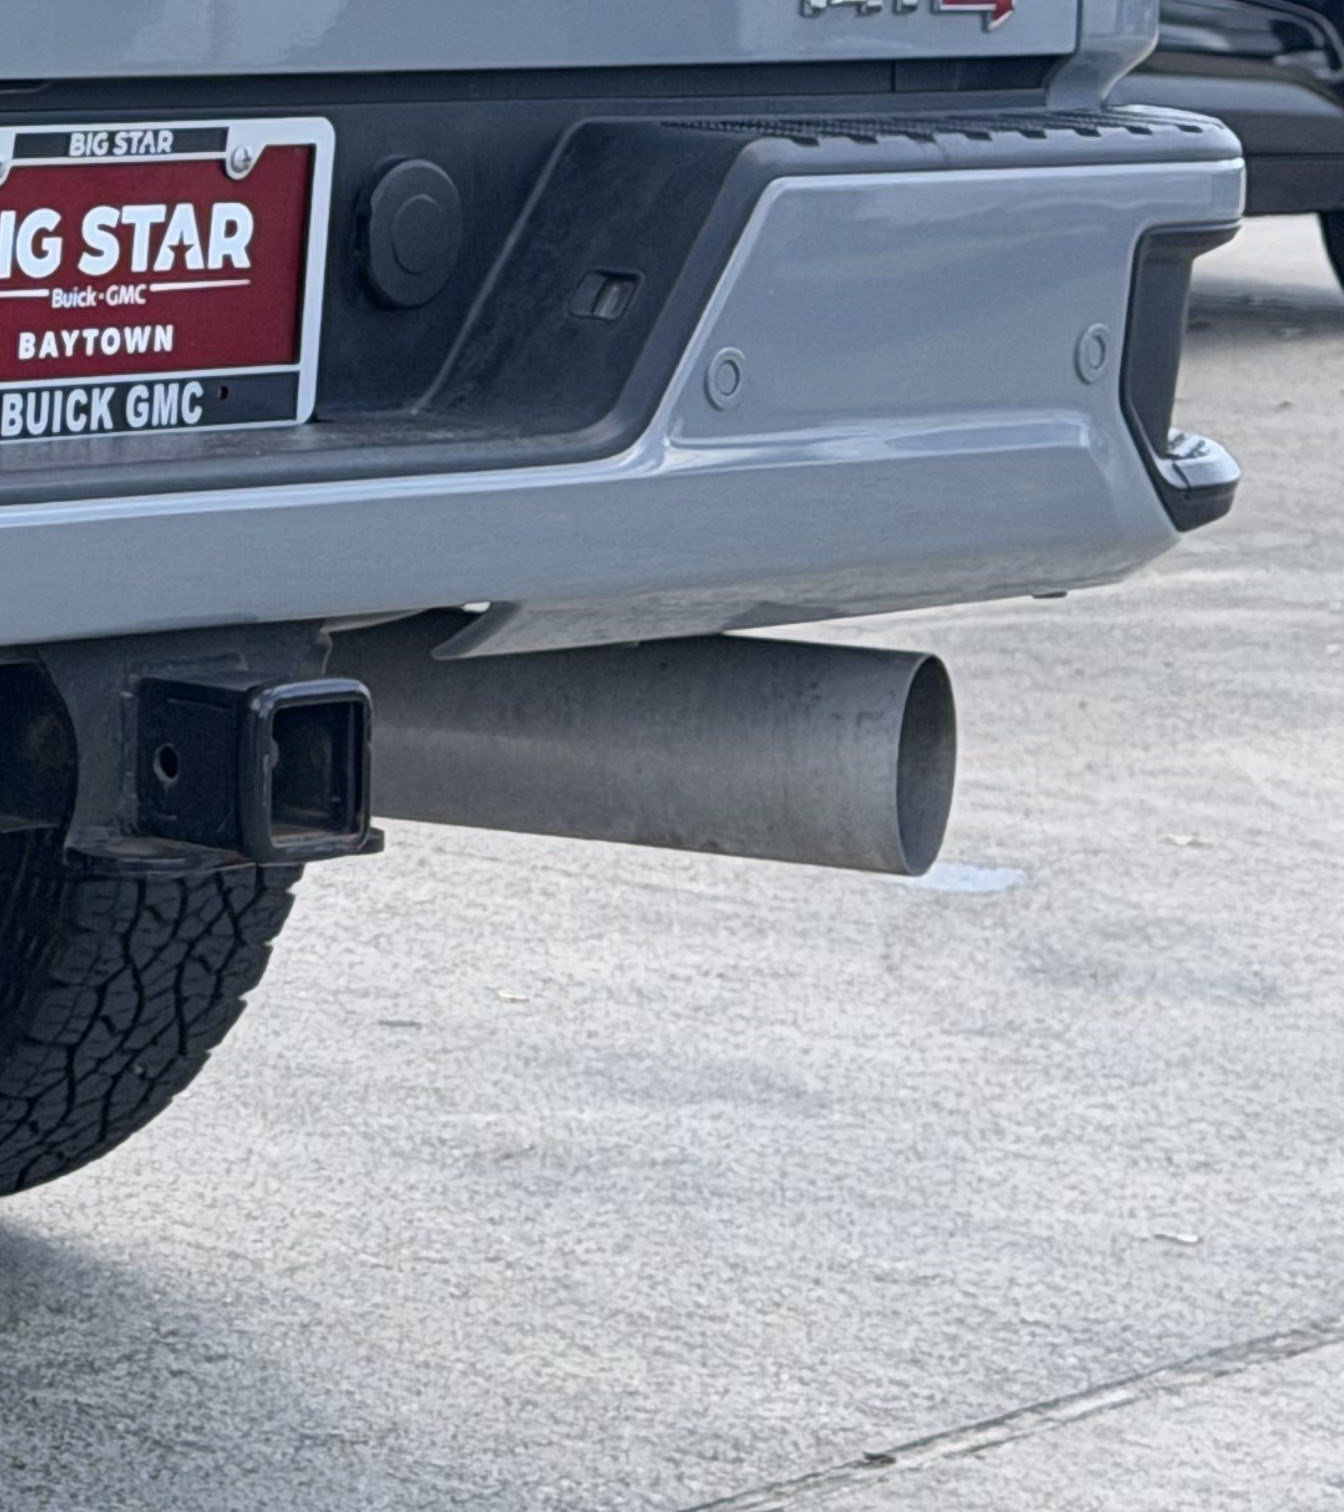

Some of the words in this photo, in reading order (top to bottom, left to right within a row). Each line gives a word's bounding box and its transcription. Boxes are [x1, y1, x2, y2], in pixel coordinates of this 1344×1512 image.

[69, 131, 110, 157] BIG
[112, 130, 173, 155] STAR
[78, 202, 254, 276] STAR
[18, 325, 174, 359] BAYTOWN
[0, 388, 113, 437] BUICK
[126, 381, 204, 427] GMC
